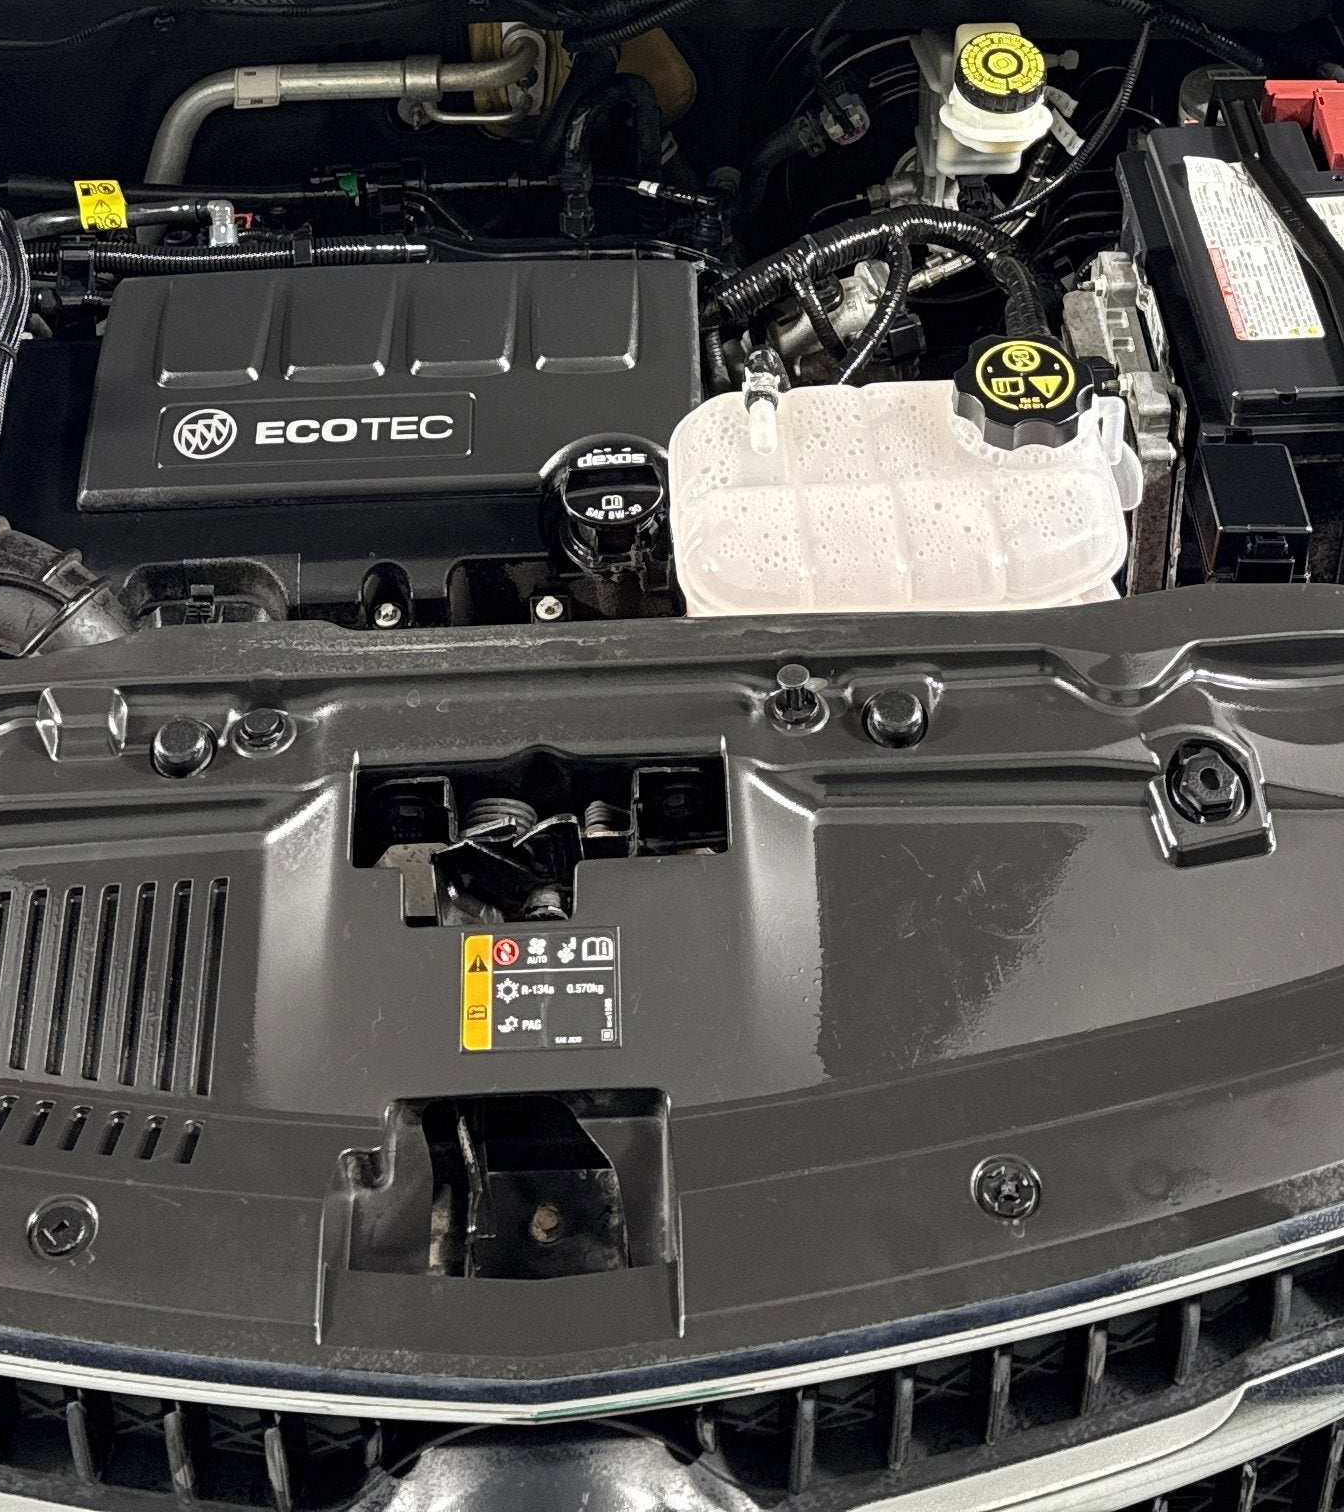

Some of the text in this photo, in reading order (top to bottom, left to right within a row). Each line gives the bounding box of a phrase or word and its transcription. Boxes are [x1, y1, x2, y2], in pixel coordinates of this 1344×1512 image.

[255, 415, 454, 444] ECOTEC
[577, 453, 648, 468] dexos
[585, 506, 606, 520] SAE
[526, 955, 548, 965] AUTO
[521, 982, 605, 995] R-134a 0.570kg
[521, 1019, 542, 1032] PAG
